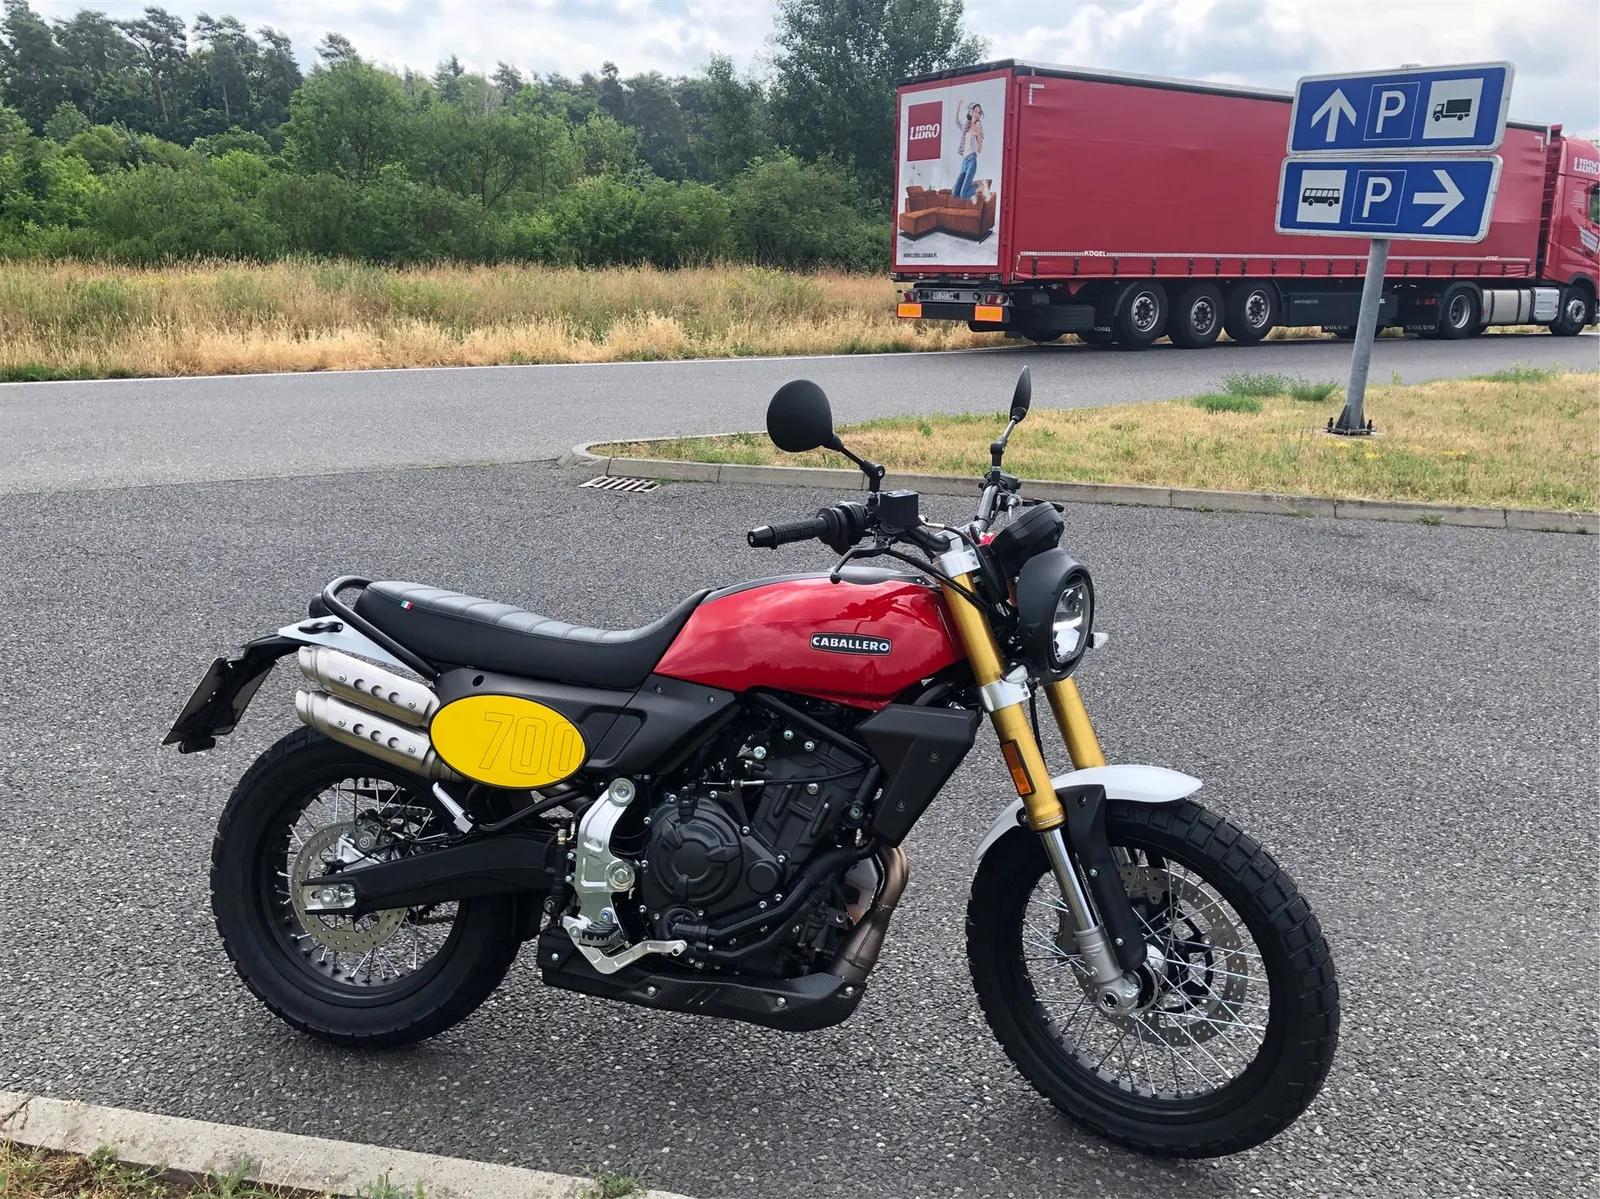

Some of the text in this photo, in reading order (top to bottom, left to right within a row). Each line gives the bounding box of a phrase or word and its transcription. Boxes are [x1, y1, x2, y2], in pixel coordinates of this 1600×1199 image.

[909, 123, 940, 141] LIBRO
[1375, 90, 1406, 133] P
[1362, 176, 1392, 218] P
[812, 636, 889, 652] CABALLERO
[478, 711, 584, 779] 700
